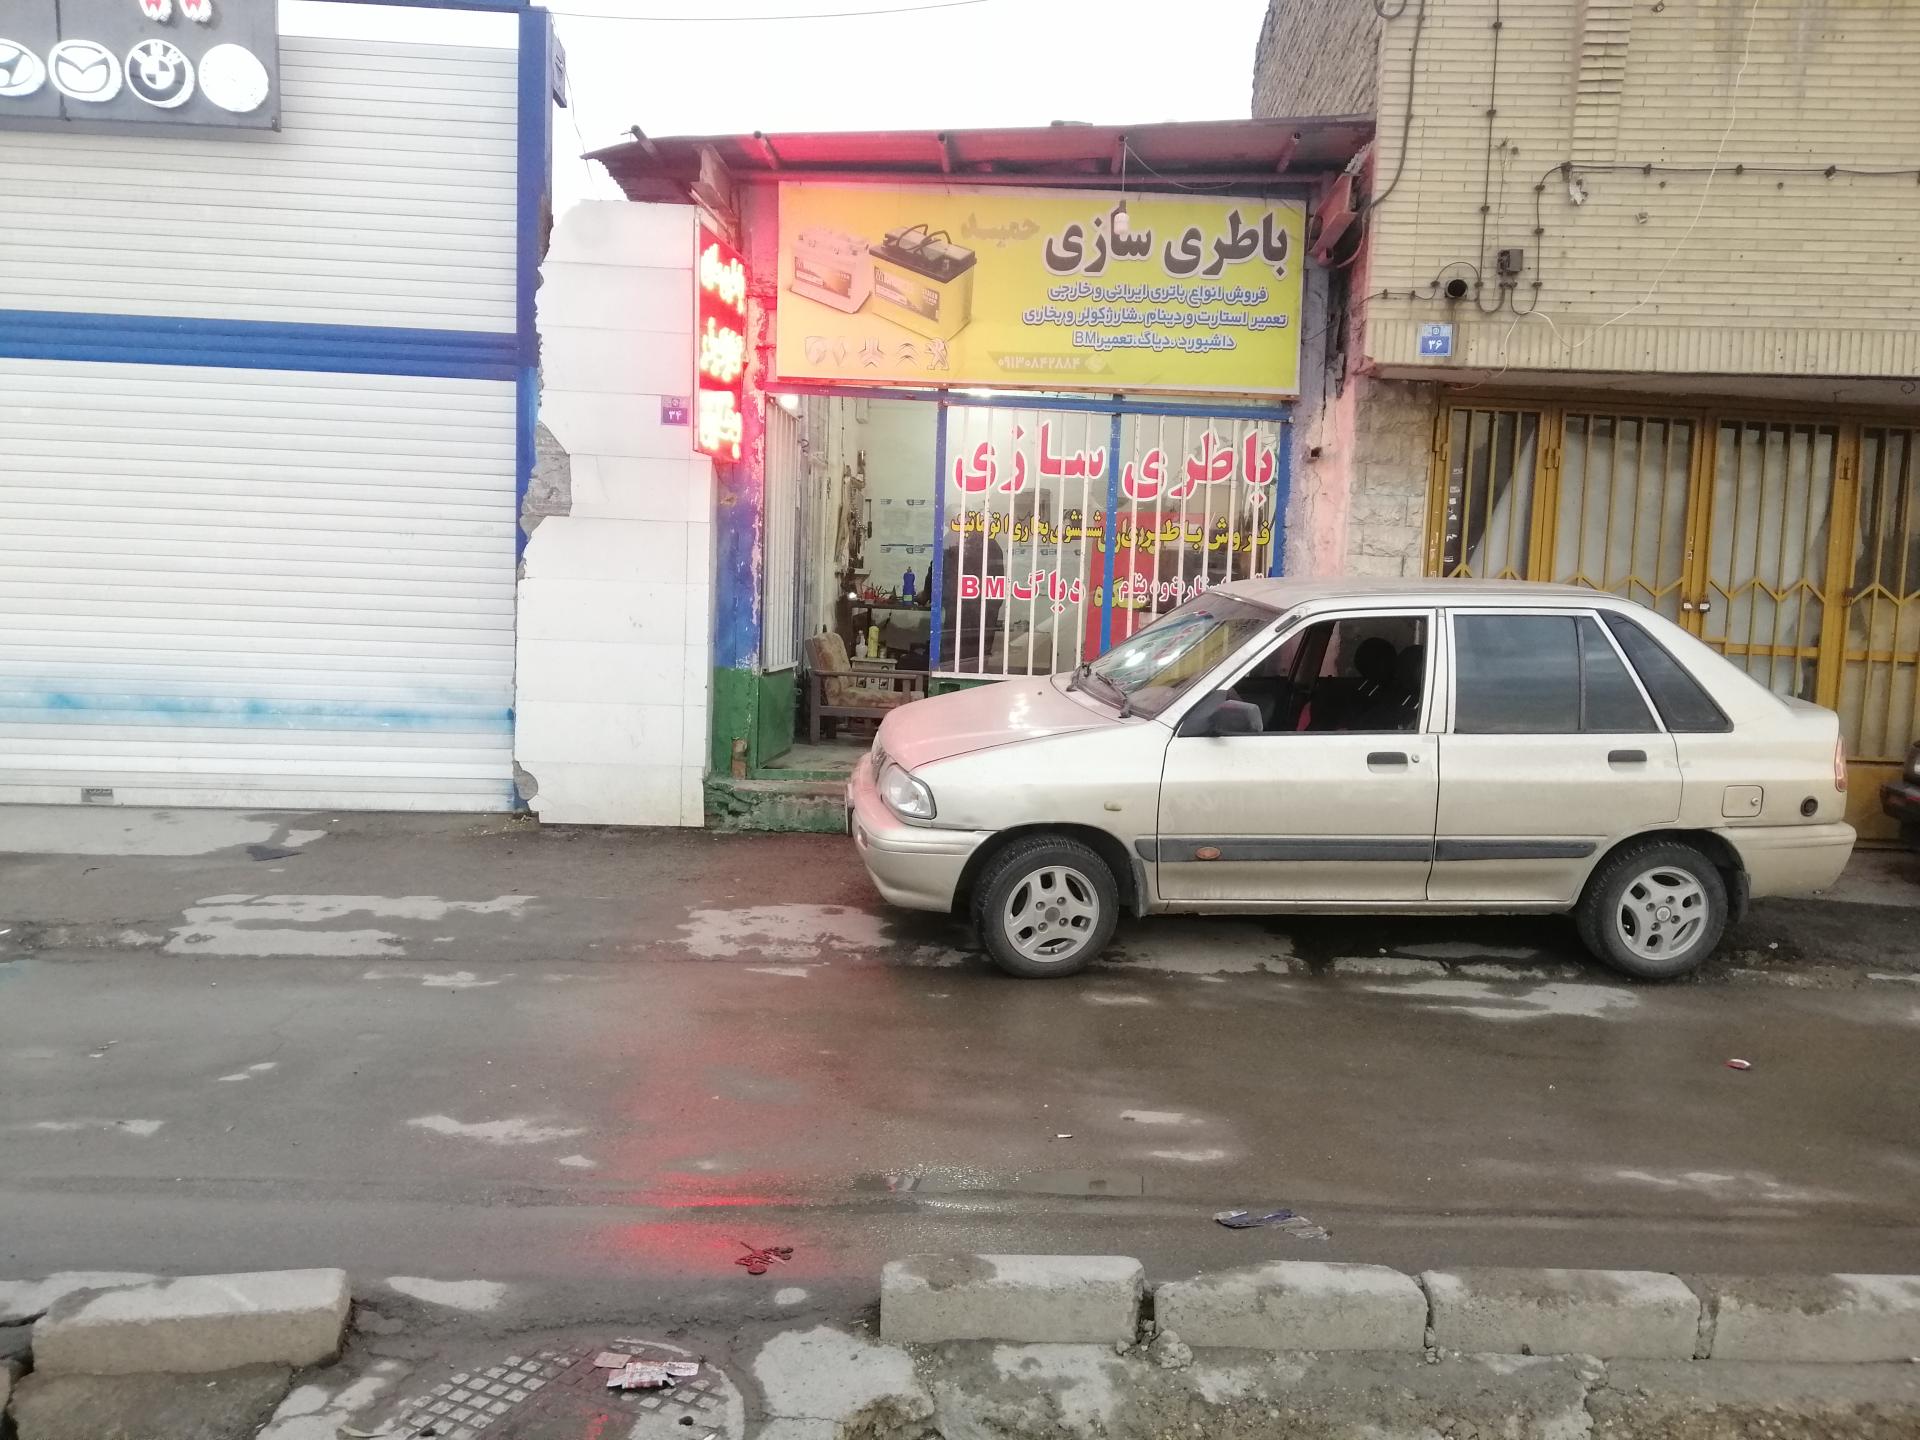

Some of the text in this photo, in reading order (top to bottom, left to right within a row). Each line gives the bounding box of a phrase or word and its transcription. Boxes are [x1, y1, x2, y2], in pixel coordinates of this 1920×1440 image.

[1045, 206, 1152, 274] سازی
[1164, 209, 1288, 278] باطری
[1106, 284, 1147, 301] ایرانی
[1149, 284, 1187, 302] باتری
[1188, 284, 1223, 306] انواع
[1224, 286, 1268, 303] فروش
[1197, 309, 1247, 328] استارت
[1250, 313, 1288, 329] تعمیر
[1428, 339, 1443, 350] ۳۶
[952, 419, 1277, 506] باطری سازی
[1208, 516, 1272, 552] فروش
[959, 574, 1009, 601] BM
[1011, 569, 1086, 615] دیاگ
